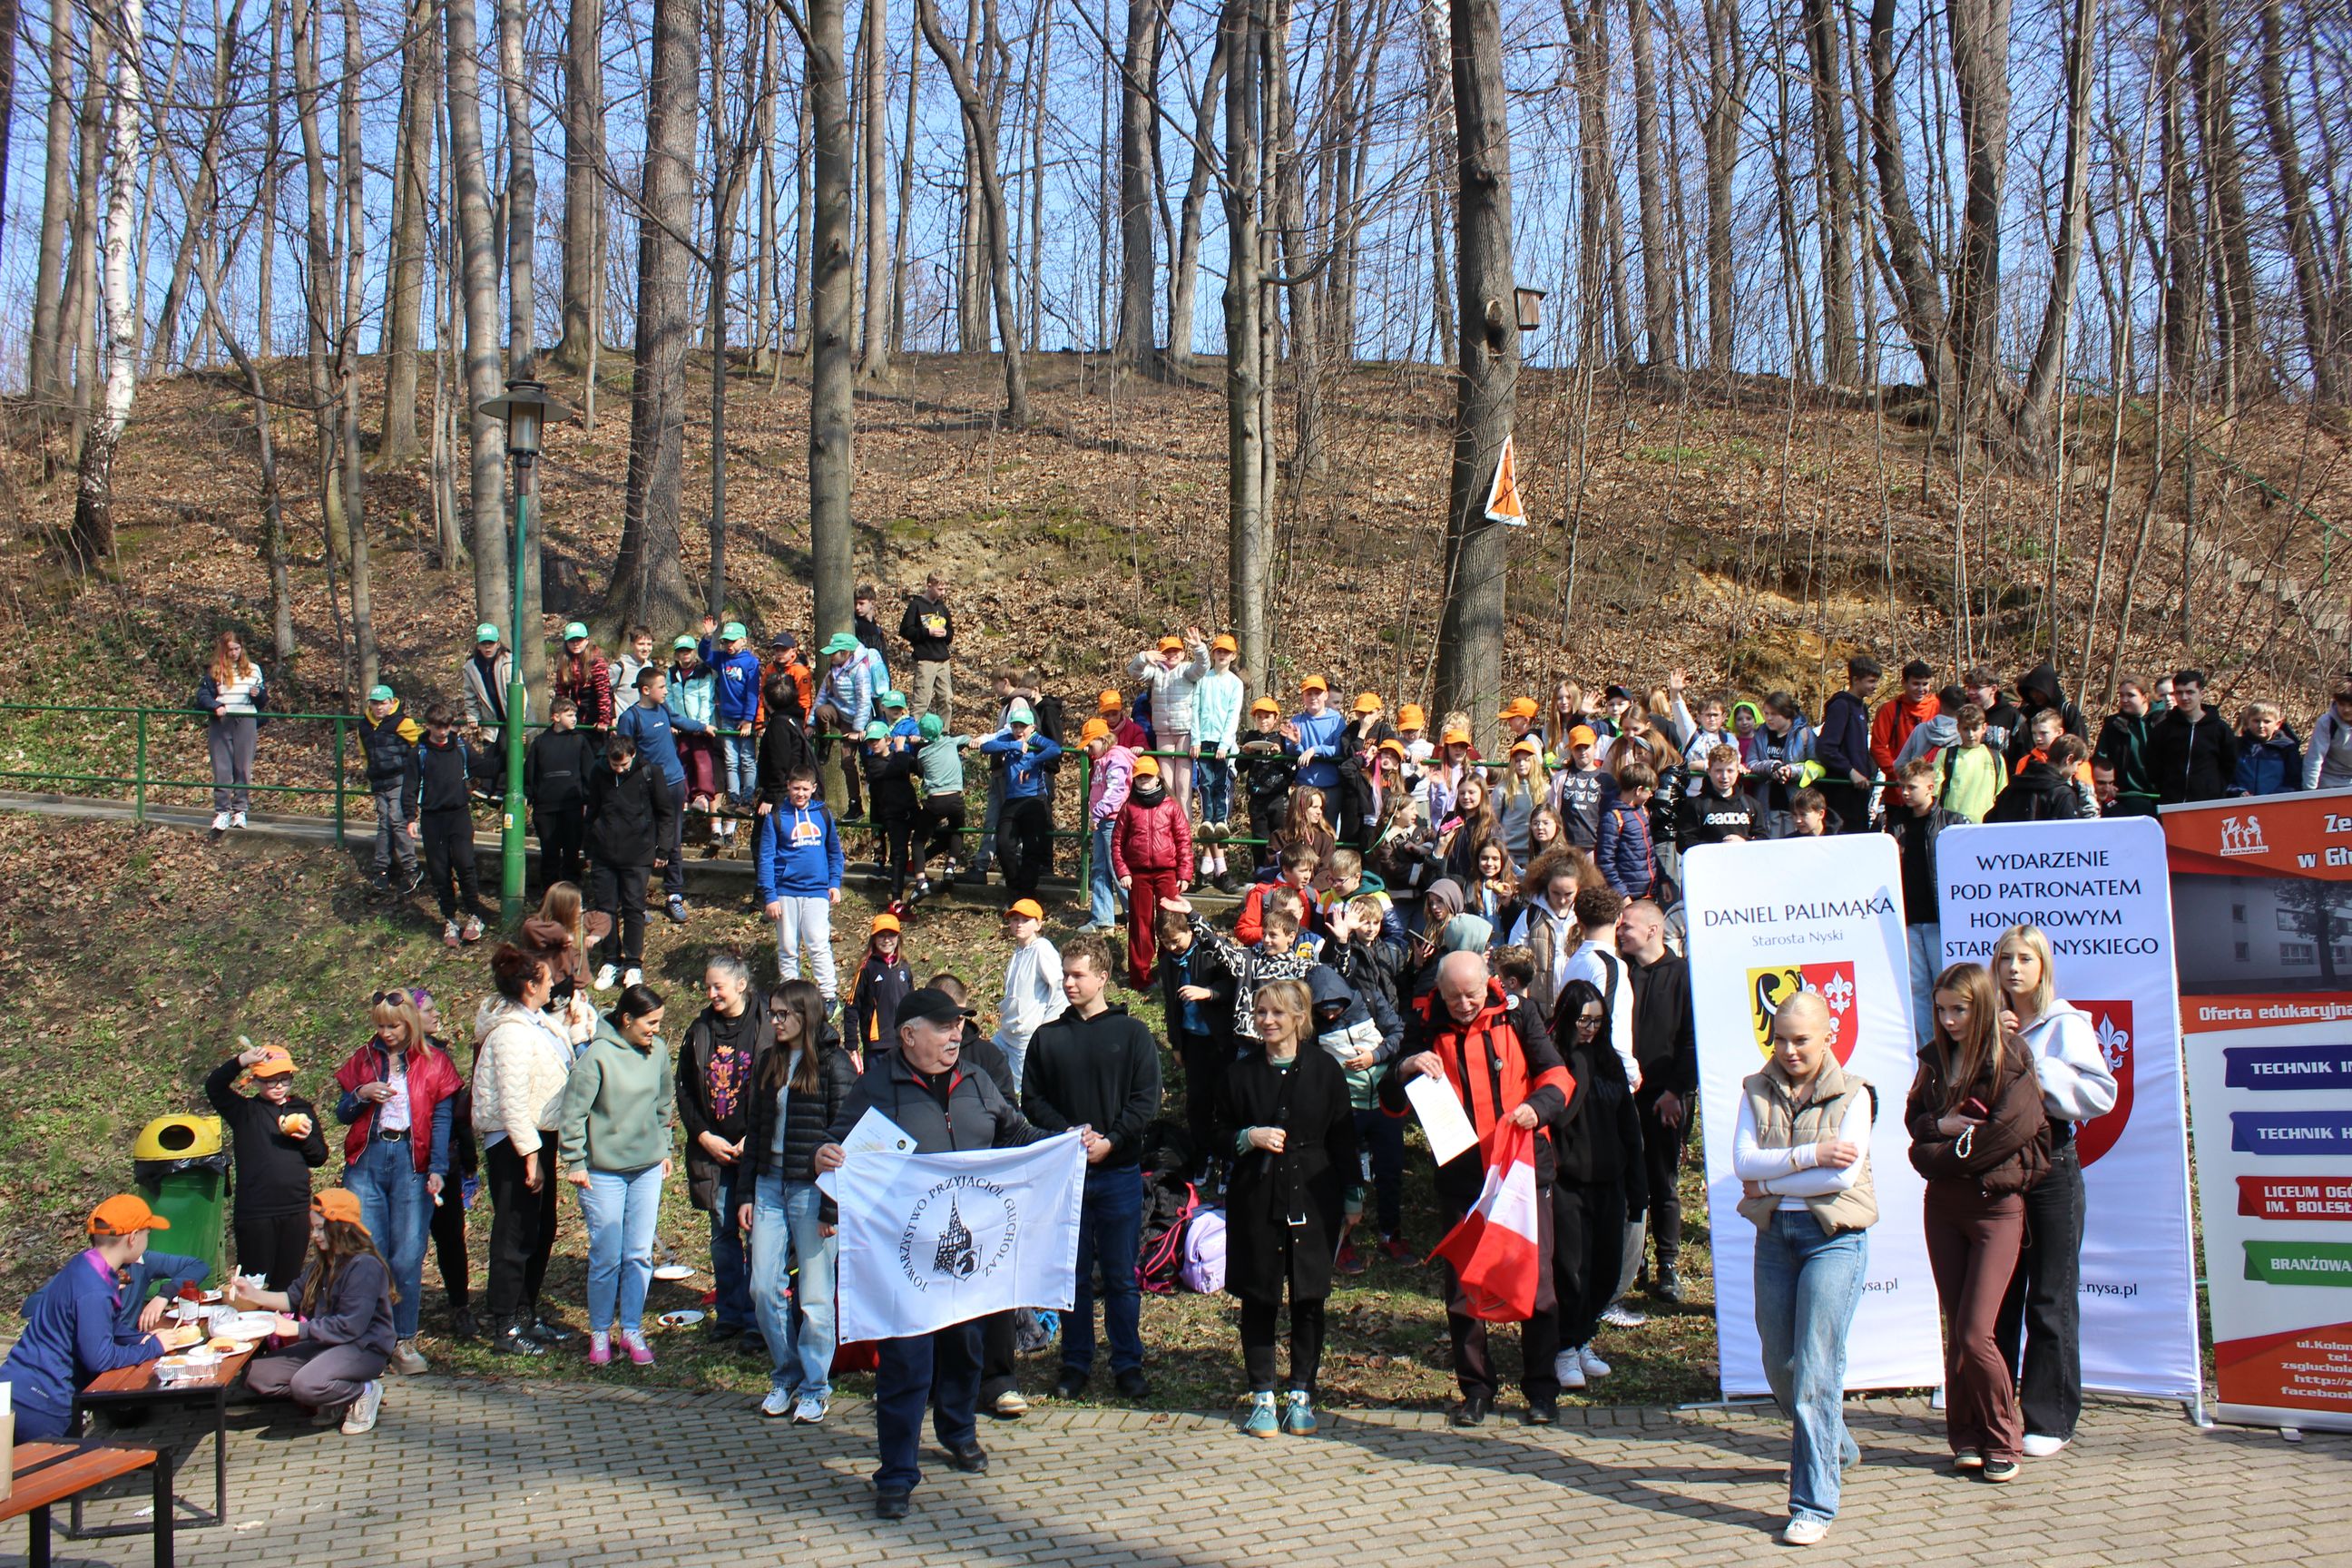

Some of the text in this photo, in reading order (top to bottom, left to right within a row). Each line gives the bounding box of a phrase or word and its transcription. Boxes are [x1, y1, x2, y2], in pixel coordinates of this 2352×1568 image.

[1976, 850, 2110, 871] WYDARZENIE
[2297, 854, 2317, 868] w
[1951, 879, 2141, 900] POD PATRONATEM
[1704, 897, 1896, 926] DANIEL PALIMĄKA
[1970, 909, 2122, 928] HONOROWYM
[1751, 930, 1844, 947] Starosta Nyski
[1945, 937, 2159, 956] STAR NYSKIEGO
[2200, 1002, 2352, 1021] Oferta edukacyjna
[2250, 1062, 2333, 1074] TECHNIK
[2258, 1127, 2334, 1140] TECHNIK
[2264, 1185, 2319, 1198] LICEUM
[2266, 1200, 2289, 1213] IM.
[899, 1198, 928, 1293] TOWARZYSTWO
[928, 1176, 1004, 1200] PRZYJACIÓŁ
[2270, 1255, 2352, 1272] BRANŻOWA
[2327, 1353, 2352, 1362] tel.
